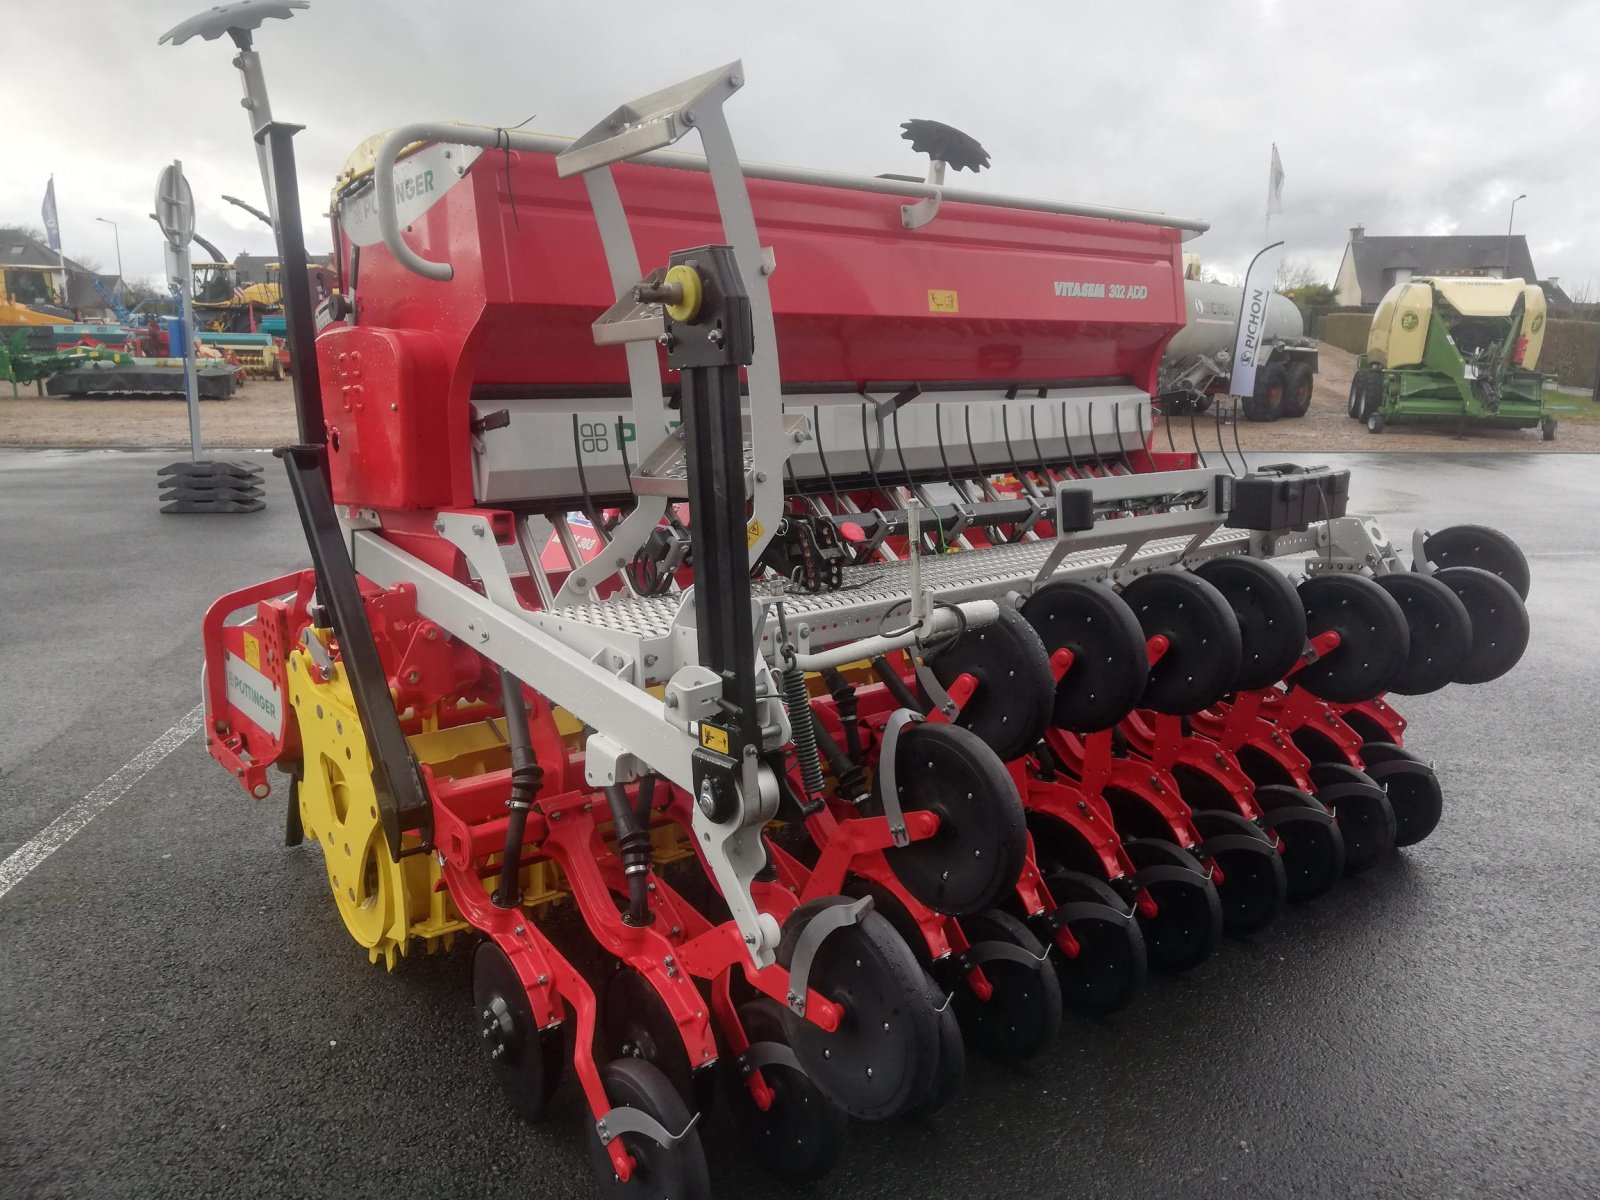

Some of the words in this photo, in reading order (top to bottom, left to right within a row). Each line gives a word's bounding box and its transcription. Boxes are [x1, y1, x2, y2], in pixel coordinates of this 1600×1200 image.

[1054, 281, 1105, 298] VITASEM
[1108, 284, 1126, 299] 302
[1126, 285, 1148, 300] ADD
[1245, 289, 1263, 349] PICHON
